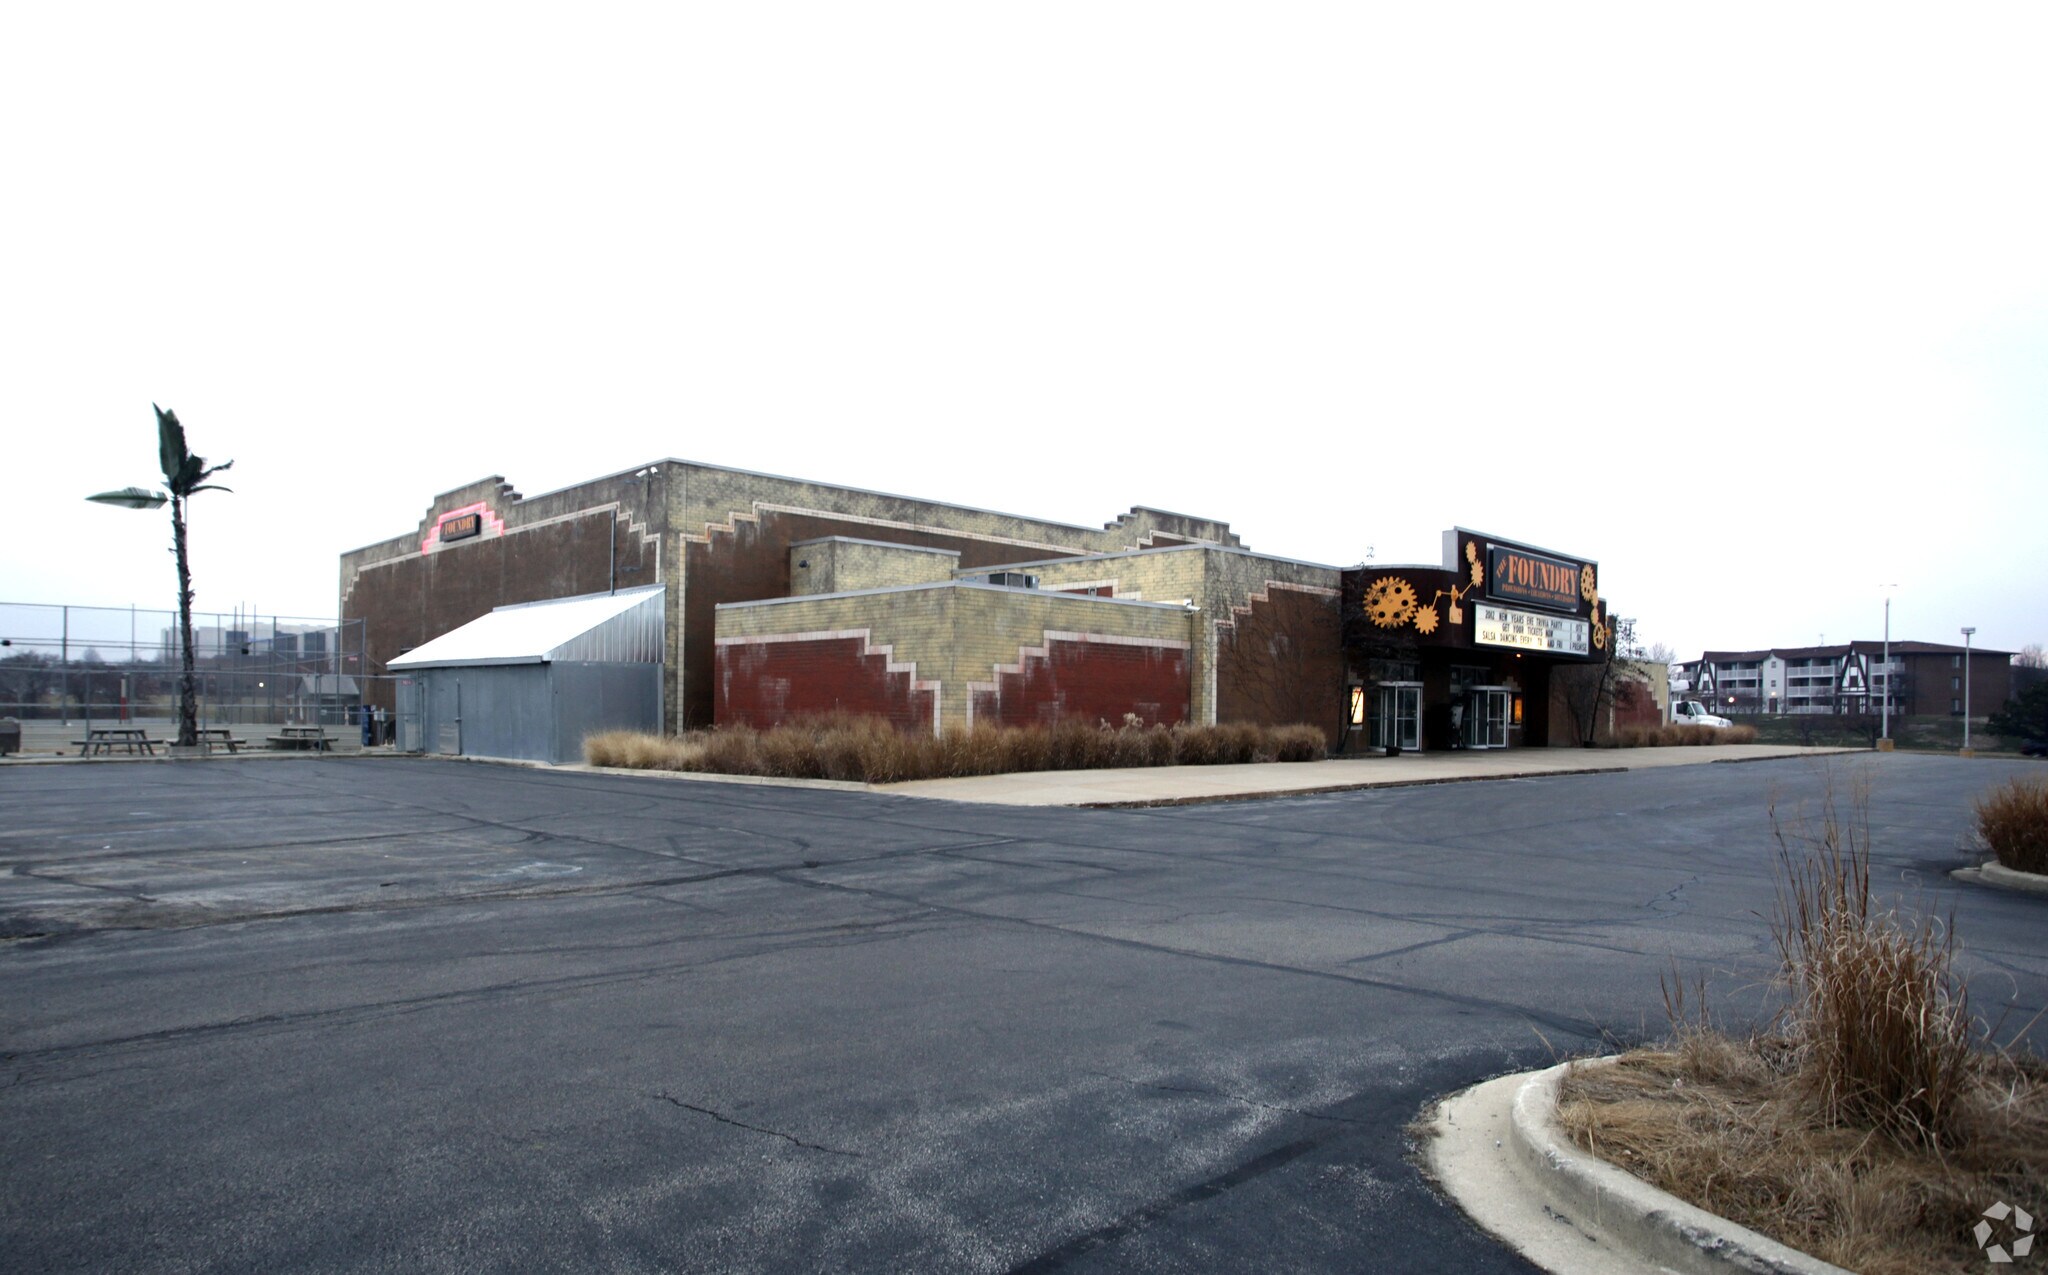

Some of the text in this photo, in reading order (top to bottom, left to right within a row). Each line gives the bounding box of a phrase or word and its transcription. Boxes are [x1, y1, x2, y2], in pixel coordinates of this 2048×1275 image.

[445, 515, 474, 535] FOUNDRY
[1495, 554, 1579, 596] THE FOUNDRY
[1499, 612, 1507, 621] NEW
[1511, 613, 1524, 624] YEARS
[1526, 615, 1534, 625] EVE
[1536, 617, 1549, 628] TRIVIA
[1550, 619, 1563, 630] PARTY
[1502, 622, 1553, 638] GET YOUR TICKETS NOW
[1482, 630, 1496, 641] SALSA
[1500, 633, 1518, 644] DANCING
[1547, 639, 1555, 648] AND
